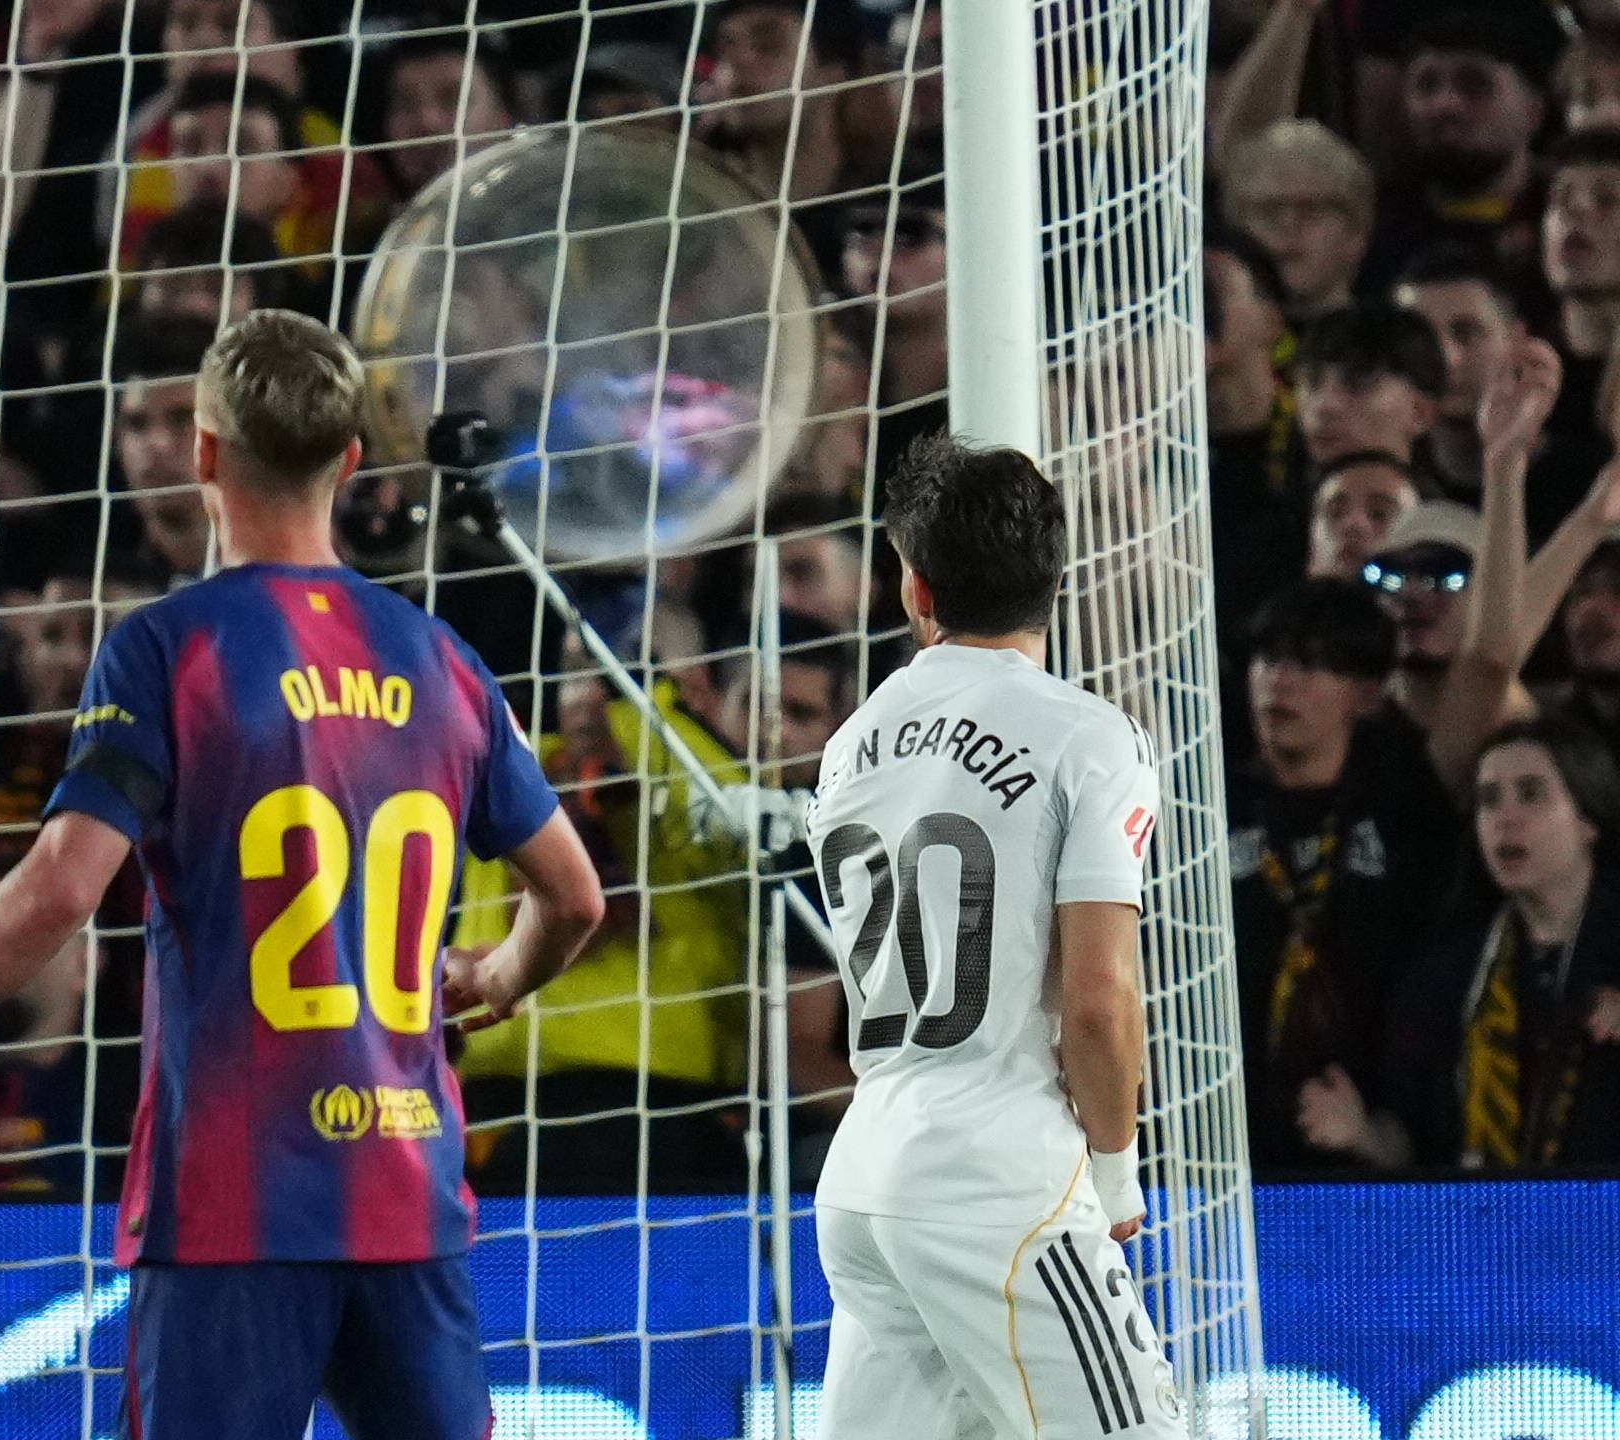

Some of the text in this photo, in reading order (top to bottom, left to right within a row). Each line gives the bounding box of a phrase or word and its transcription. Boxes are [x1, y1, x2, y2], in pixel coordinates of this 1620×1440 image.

[280, 665, 413, 728] OLMO
[894, 717, 1038, 811] GARCÍA
[239, 783, 456, 1034] 20
[820, 811, 997, 1052] 20
